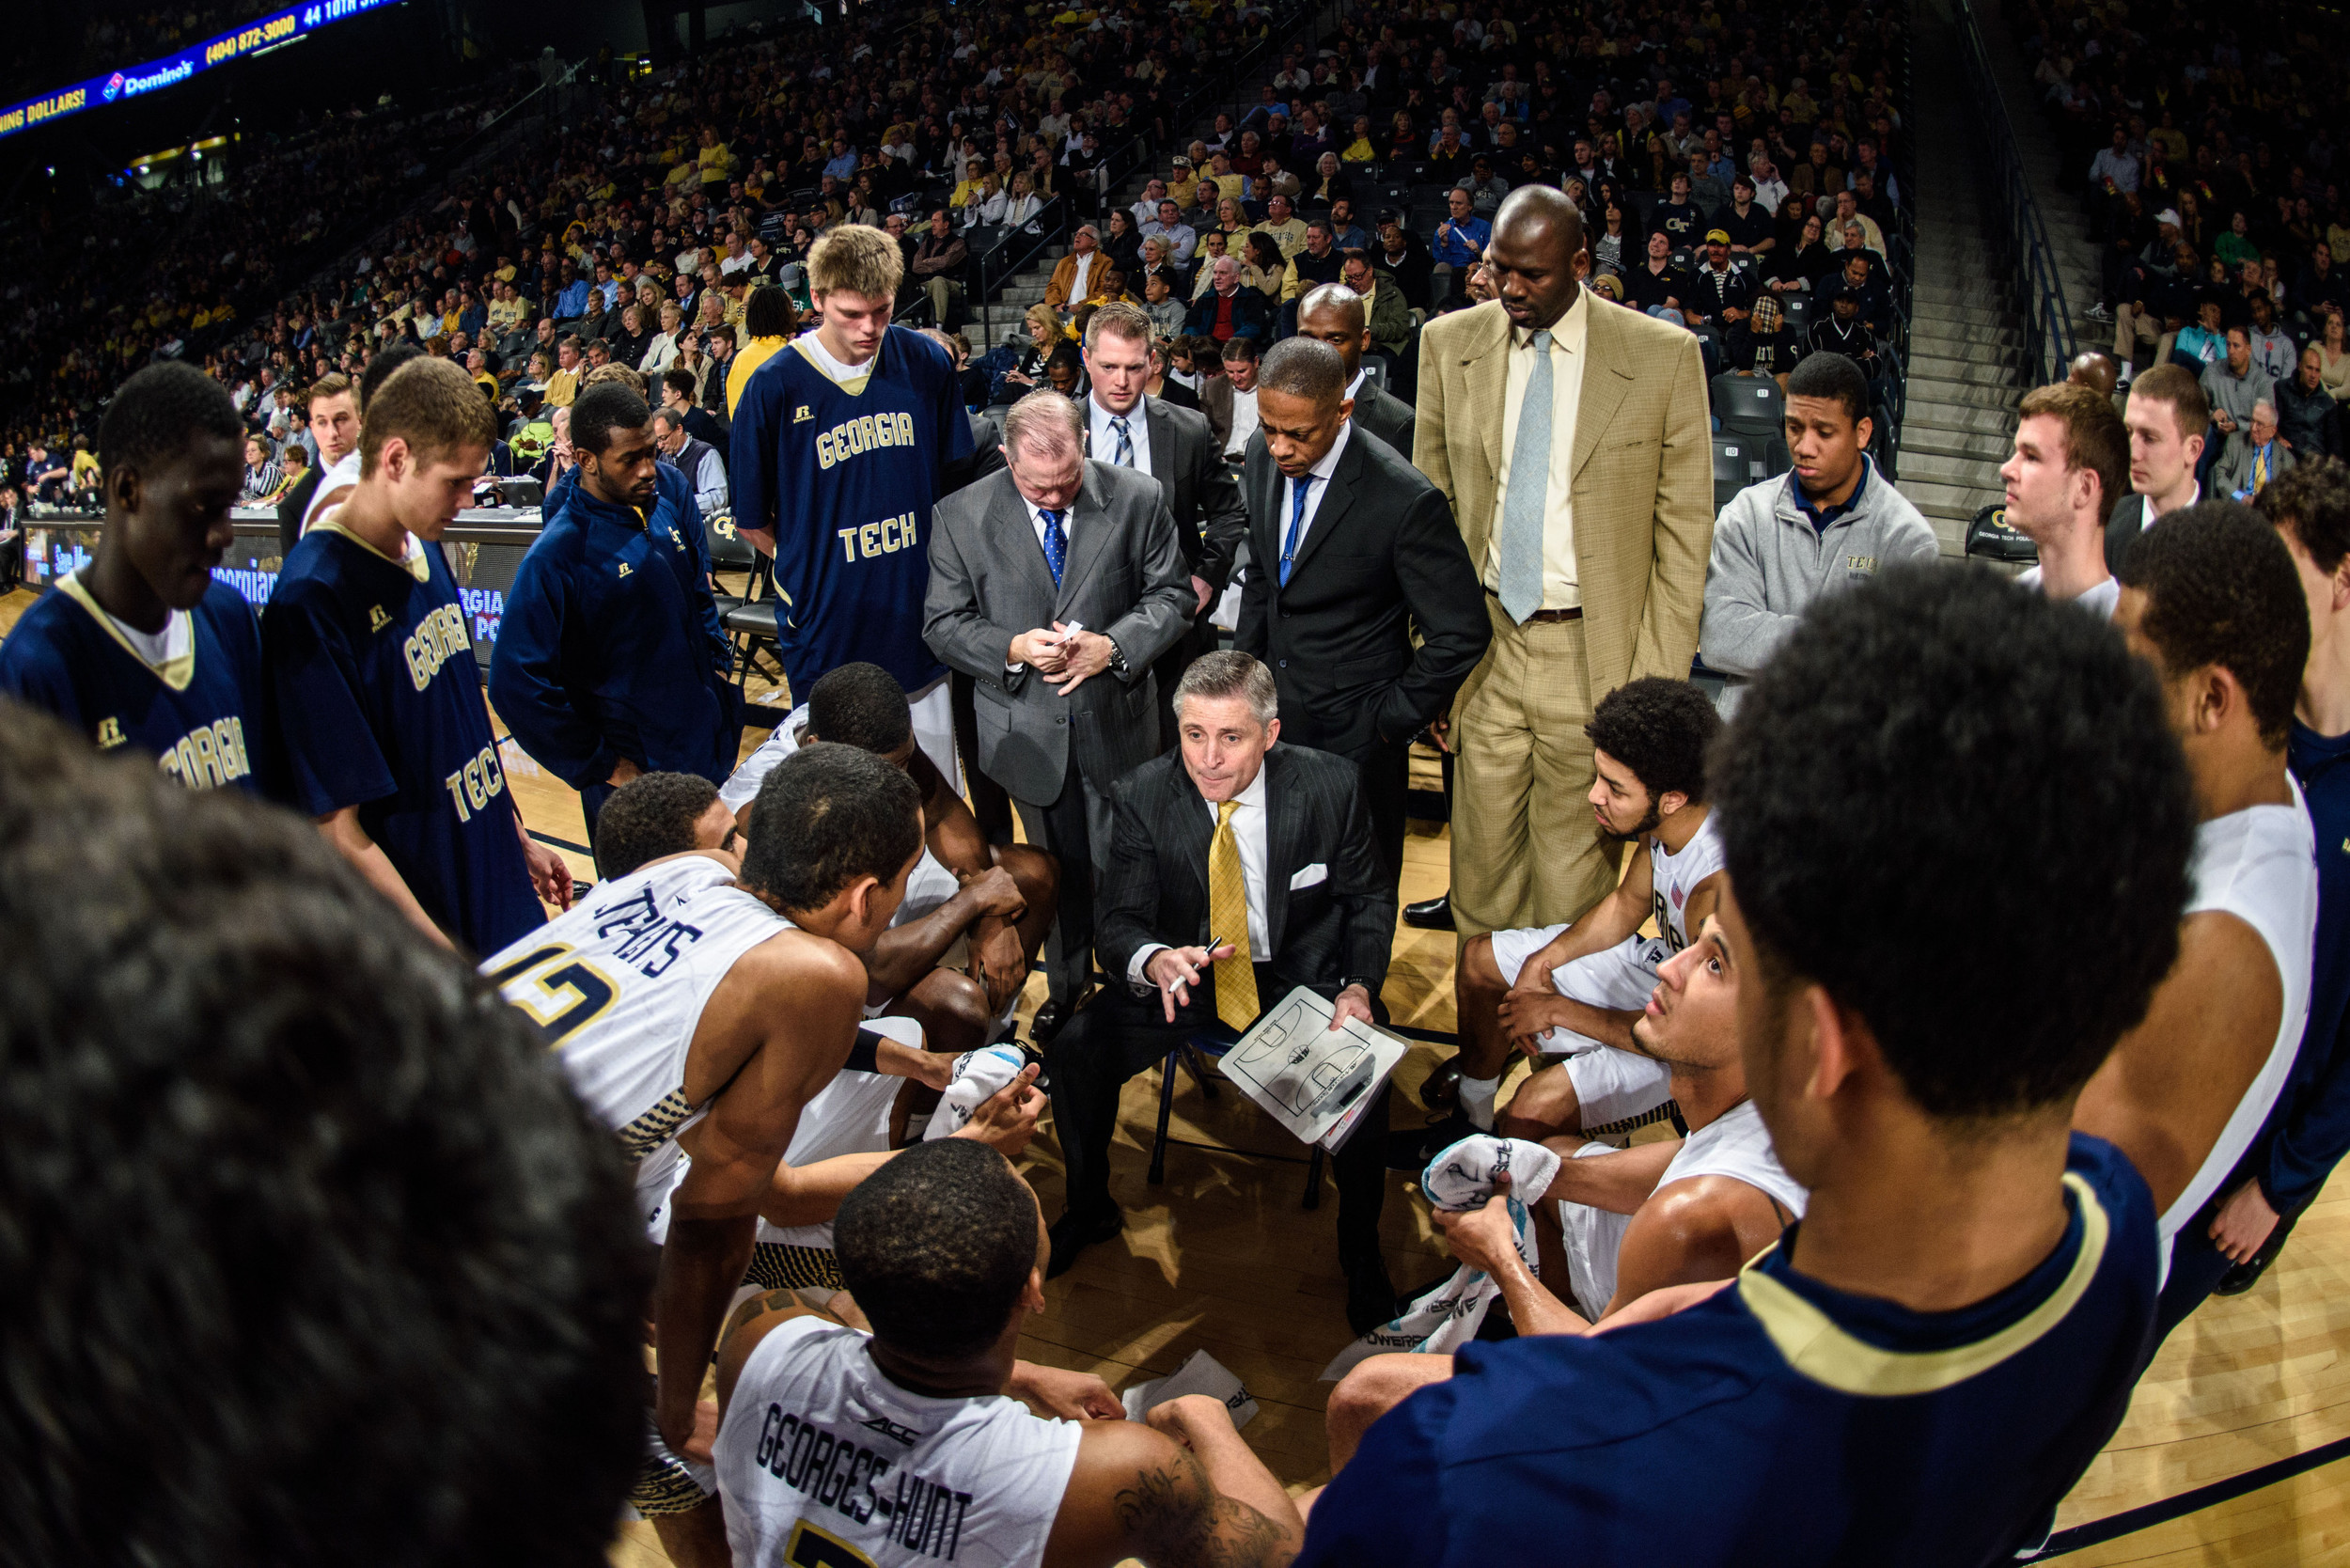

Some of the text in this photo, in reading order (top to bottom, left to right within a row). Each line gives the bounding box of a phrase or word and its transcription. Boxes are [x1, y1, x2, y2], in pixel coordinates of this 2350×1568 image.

[304, 5, 321, 26] 44
[206, 14, 295, 65] (404) 872-3000
[125, 60, 194, 95] Domino's
[0, 88, 86, 133] ING DOLLARS!
[1666, 217, 1690, 233] GT
[816, 412, 915, 470] GEORGIA
[838, 511, 916, 563] TECH
[1978, 531, 1999, 540] GEORGIA
[446, 740, 505, 823] TEC
[858, 1417, 922, 1447] ACC
[756, 1402, 974, 1562] GEORGES-HUNT
